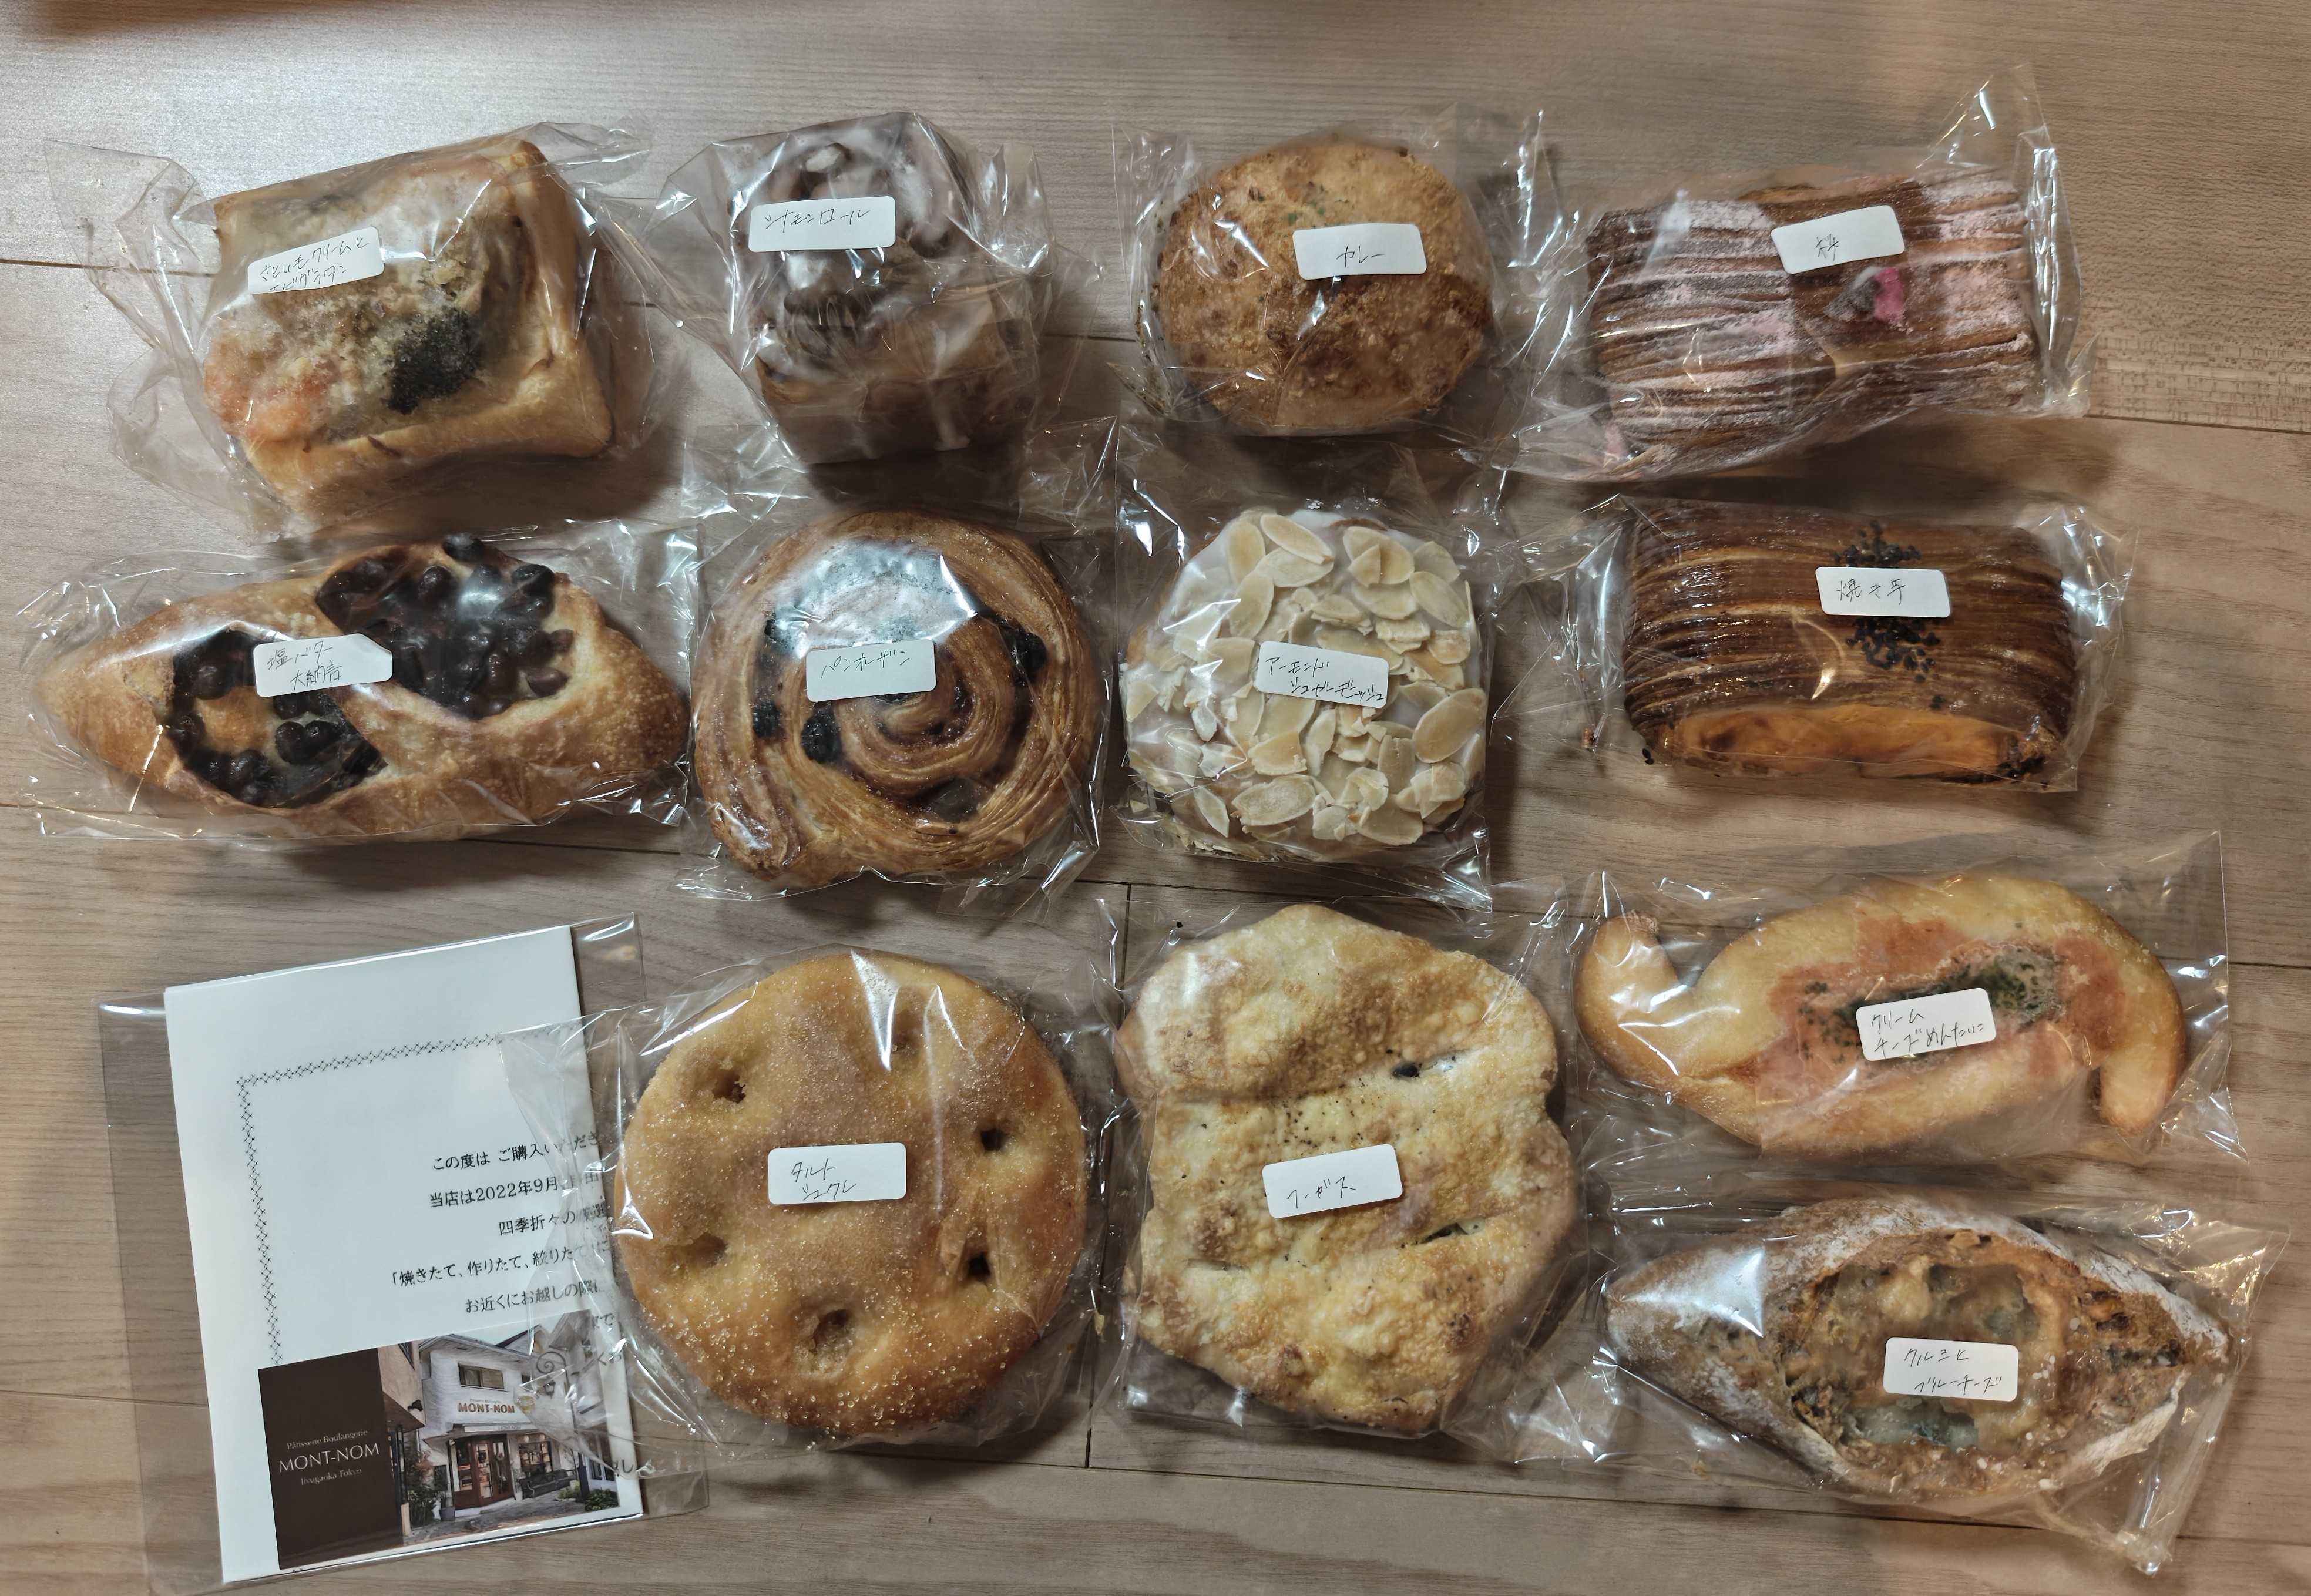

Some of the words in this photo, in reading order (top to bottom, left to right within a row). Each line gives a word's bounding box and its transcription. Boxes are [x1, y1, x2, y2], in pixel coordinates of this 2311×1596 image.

[1335, 245, 1385, 268] カレー
[1836, 577, 1906, 606] 焼き芋
[266, 640, 334, 671] 塩バター
[820, 649, 911, 679] パンオレザン
[1265, 656, 1329, 677] アーモンド
[290, 659, 342, 691] 大納言
[1871, 1008, 1924, 1034] クリーム
[432, 1151, 491, 1171] この度は
[791, 1157, 837, 1183] タルト
[802, 1180, 857, 1201] シュクレ
[1286, 1175, 1357, 1209] フーガス
[1903, 1348, 1970, 1367] クルミと
[1914, 1373, 2002, 1396] ブルーチーズ
[458, 1402, 516, 1414] MONT-NOM
[279, 1442, 380, 1473] MONT-NOM
